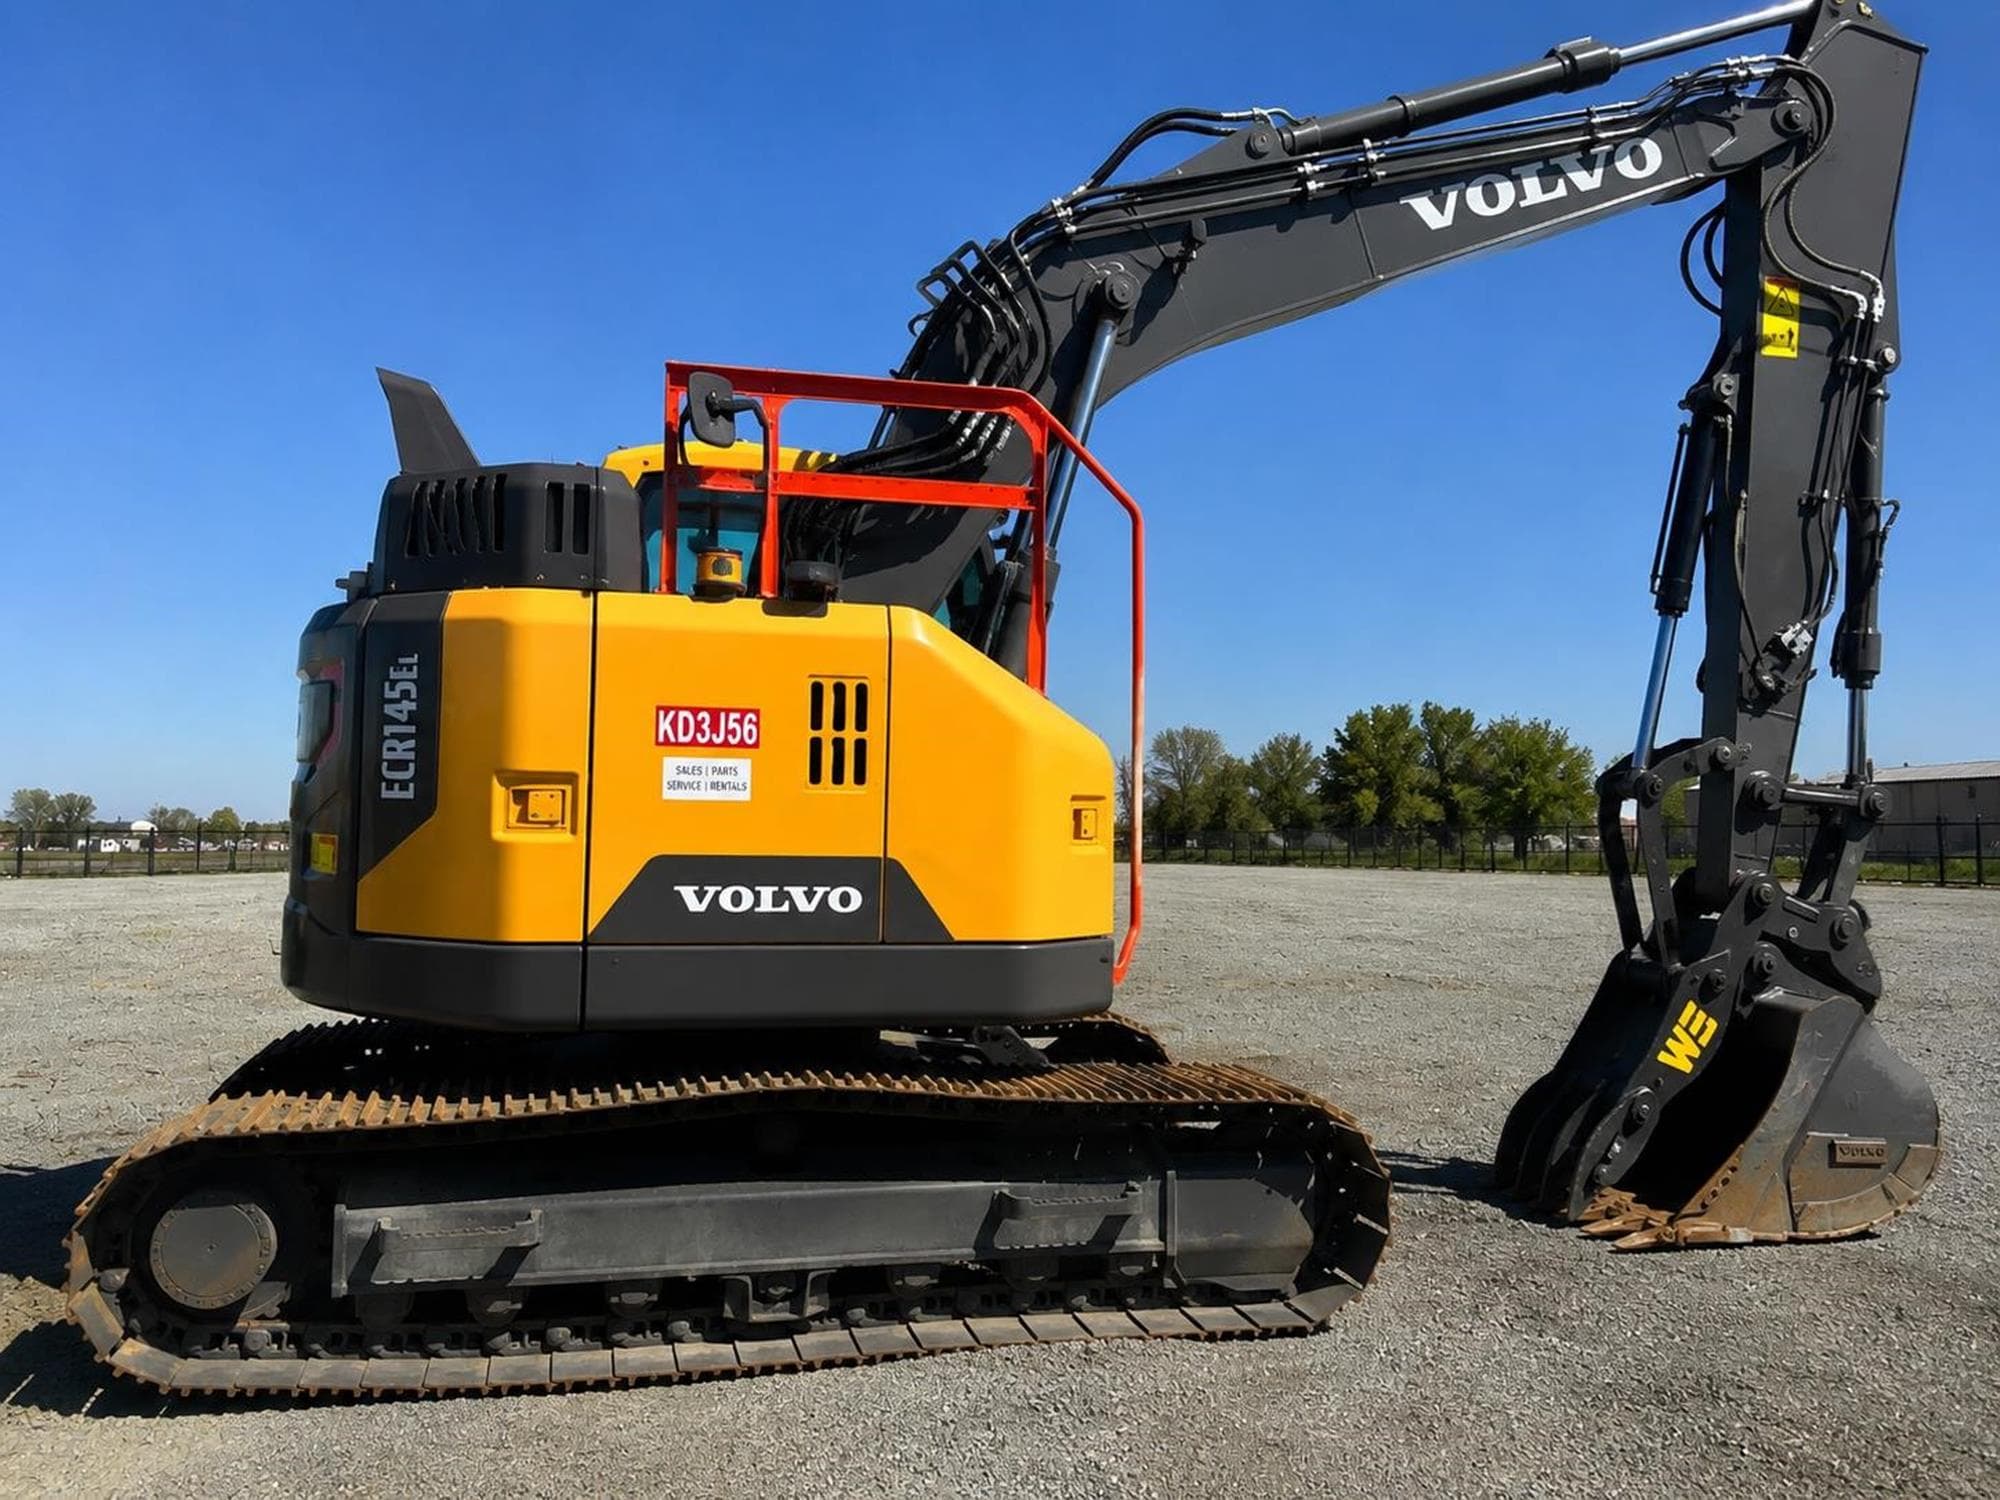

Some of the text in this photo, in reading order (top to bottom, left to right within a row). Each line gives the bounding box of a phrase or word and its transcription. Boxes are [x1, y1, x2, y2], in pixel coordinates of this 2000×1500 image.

[1400, 137, 1663, 230] VOLVO
[657, 710, 758, 745] KD3J56
[675, 765, 738, 778] SALES PARTS
[666, 780, 747, 792] SERVICE RENTALS
[673, 885, 863, 913] VOLVO
[1839, 1146, 1884, 1157] VOLVO
